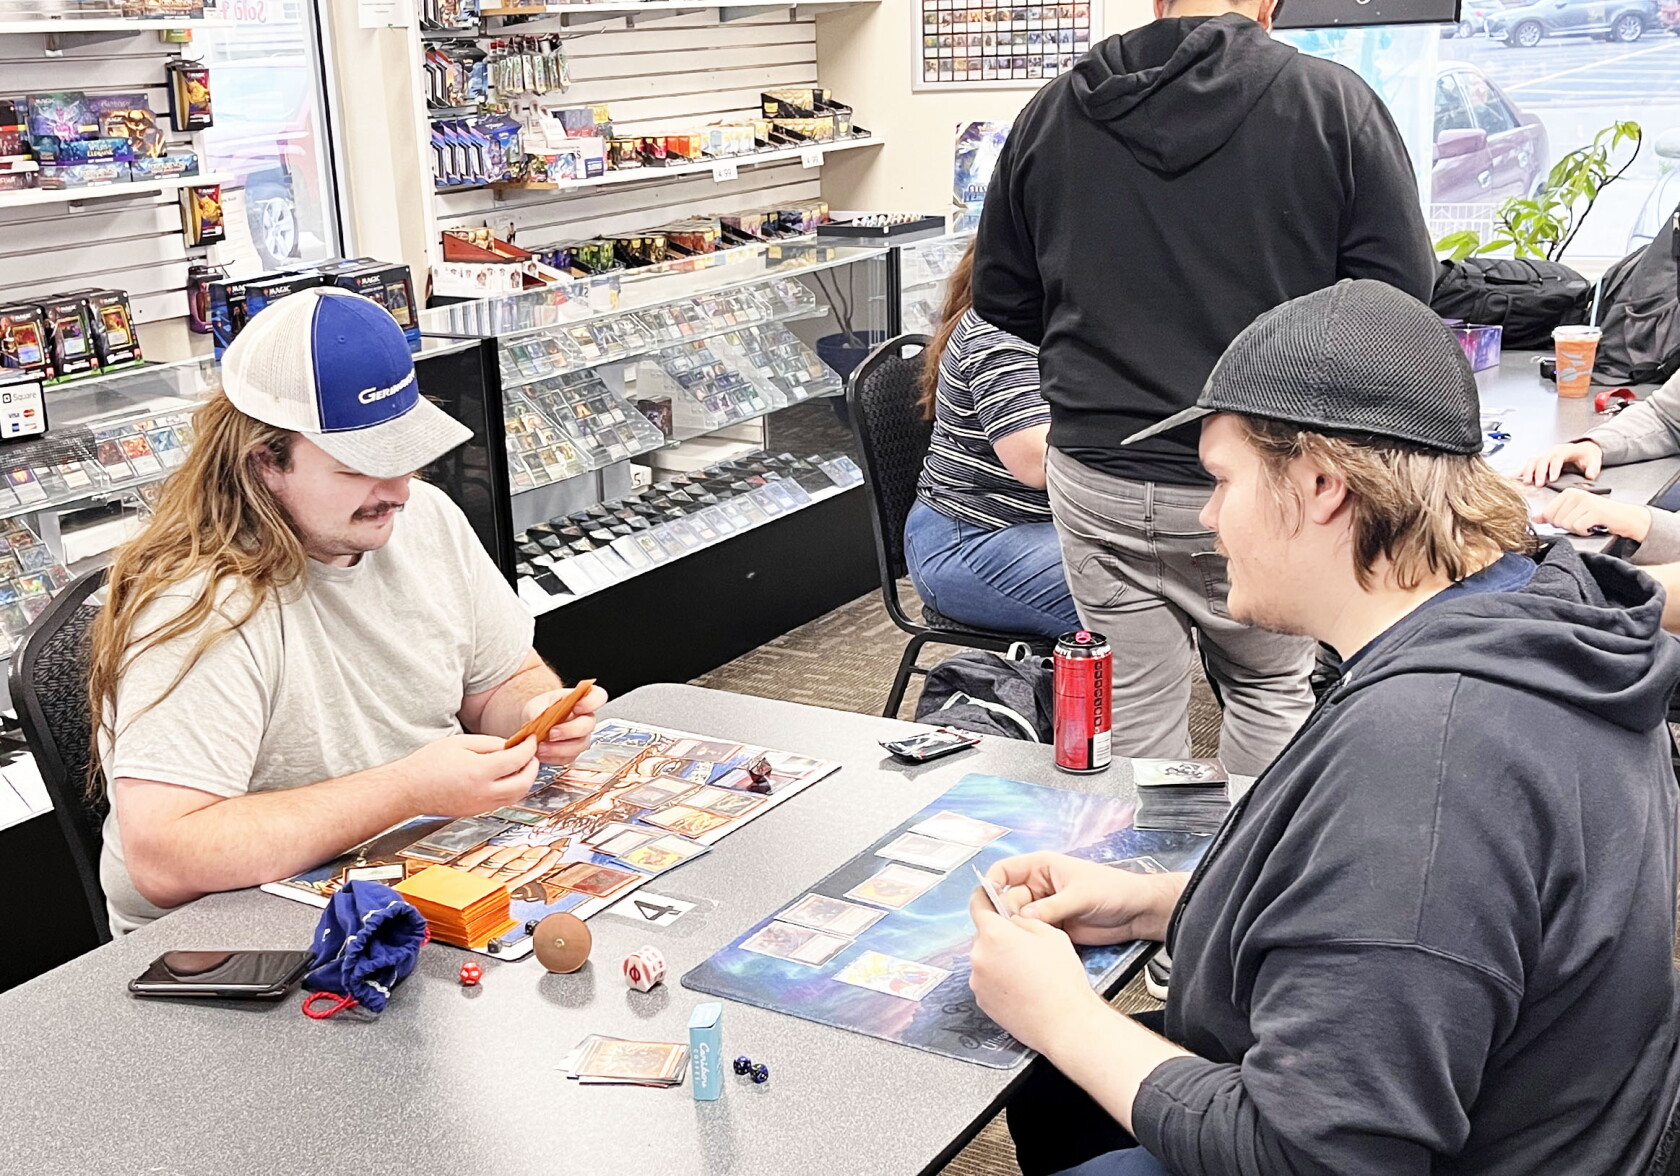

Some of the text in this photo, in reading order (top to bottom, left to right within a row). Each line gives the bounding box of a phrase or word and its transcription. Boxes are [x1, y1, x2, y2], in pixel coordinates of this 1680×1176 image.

[361, 275, 381, 286] MAGIC
[269, 285, 291, 296] MAGIC
[13, 393, 37, 401] Square
[633, 900, 683, 921] 4
[699, 1042, 710, 1089] Caribou
